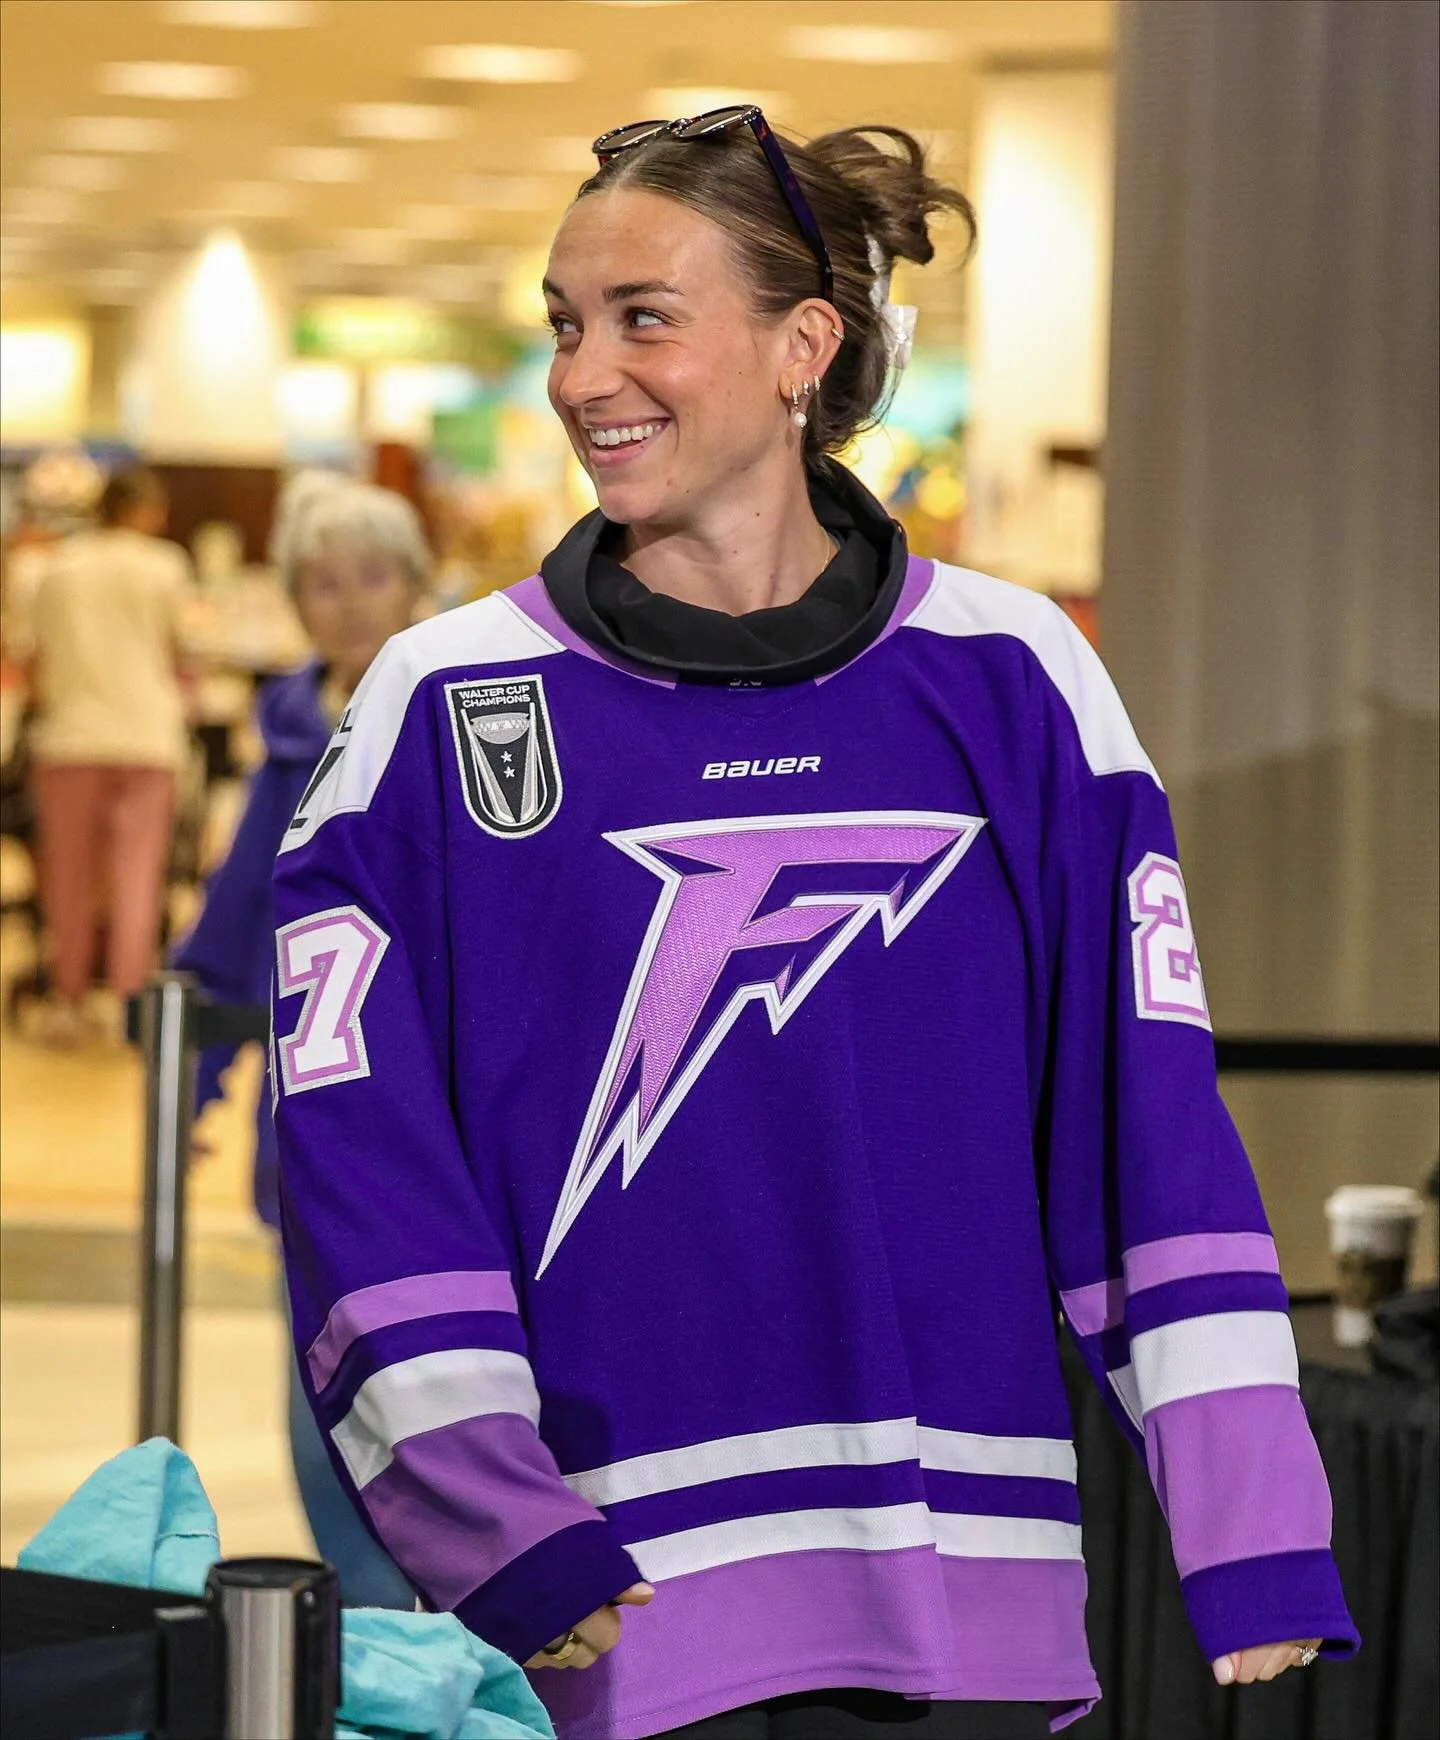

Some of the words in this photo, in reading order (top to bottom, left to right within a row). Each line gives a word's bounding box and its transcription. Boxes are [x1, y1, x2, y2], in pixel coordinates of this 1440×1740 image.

[458, 687, 505, 700] WALTER
[506, 684, 530, 695] CUP
[462, 694, 531, 708] CHAMPIONS
[269, 904, 391, 1118] 7
